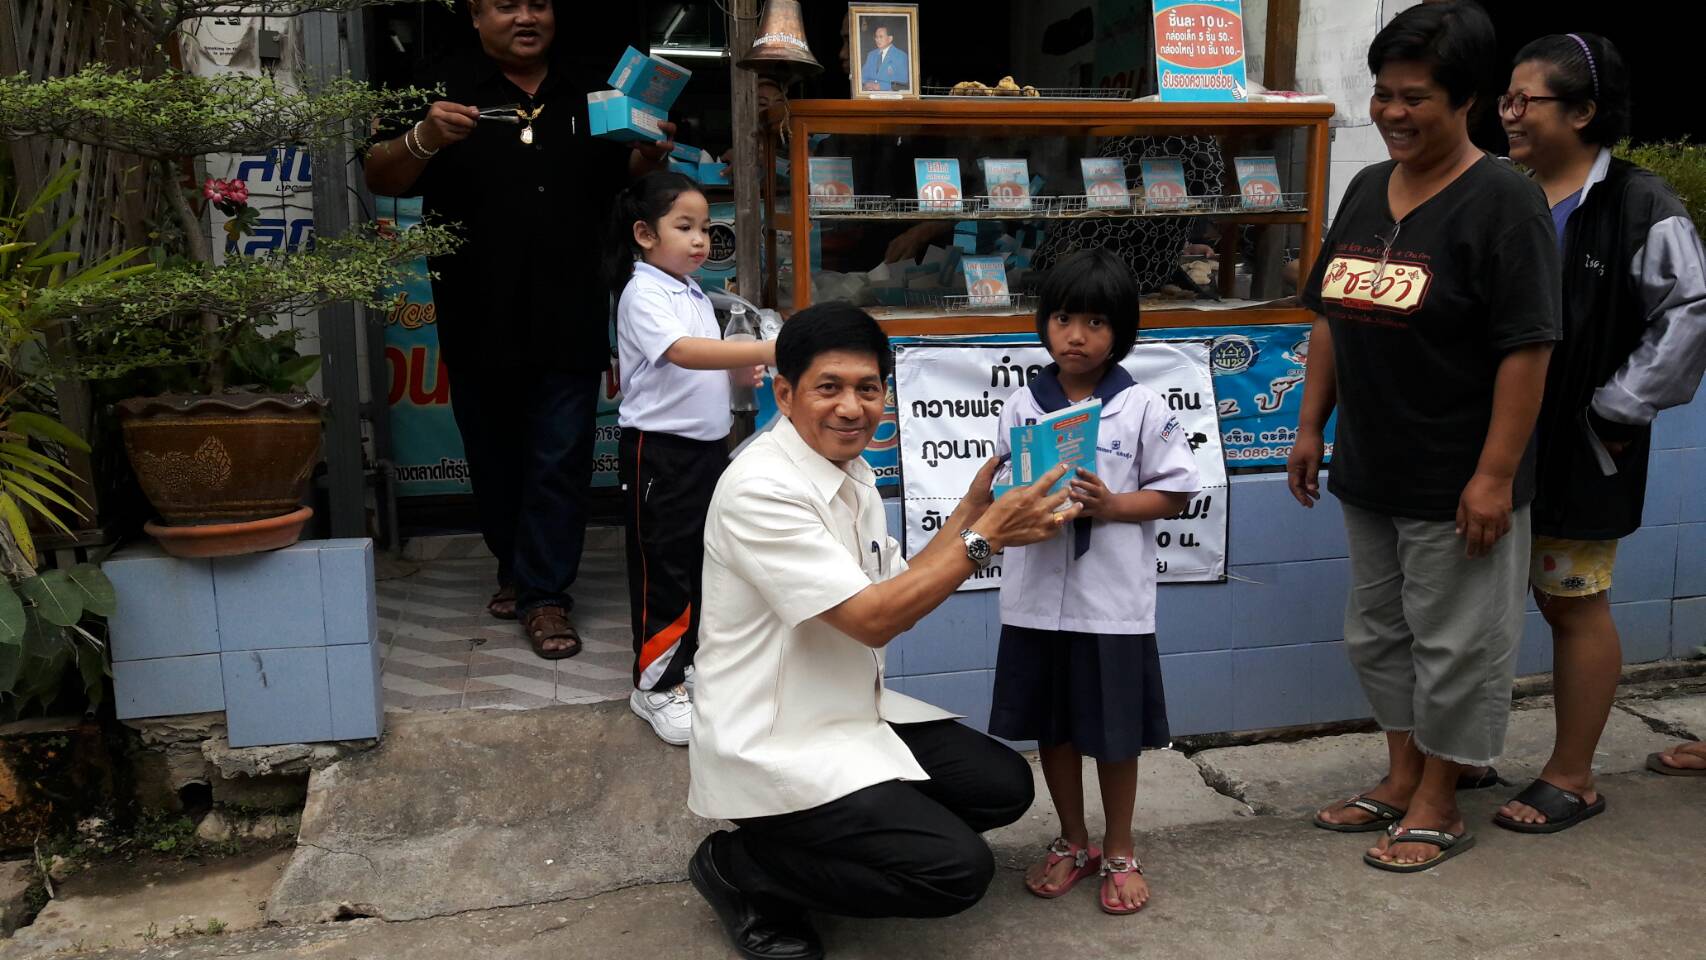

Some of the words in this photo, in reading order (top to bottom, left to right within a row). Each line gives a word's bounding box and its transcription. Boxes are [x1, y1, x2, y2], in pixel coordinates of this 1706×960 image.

[1200, 16, 1215, 28] 10
[1198, 32, 1204, 41] 5
[1218, 32, 1233, 41] 50.-
[1197, 46, 1205, 55] 10
[1221, 46, 1241, 55] 100.-
[1163, 68, 1233, 89] รับรองความอร่อย
[911, 390, 1005, 418] ถวายพ่อ
[1222, 430, 1253, 443] งชิม
[1261, 428, 1299, 441] จะติด
